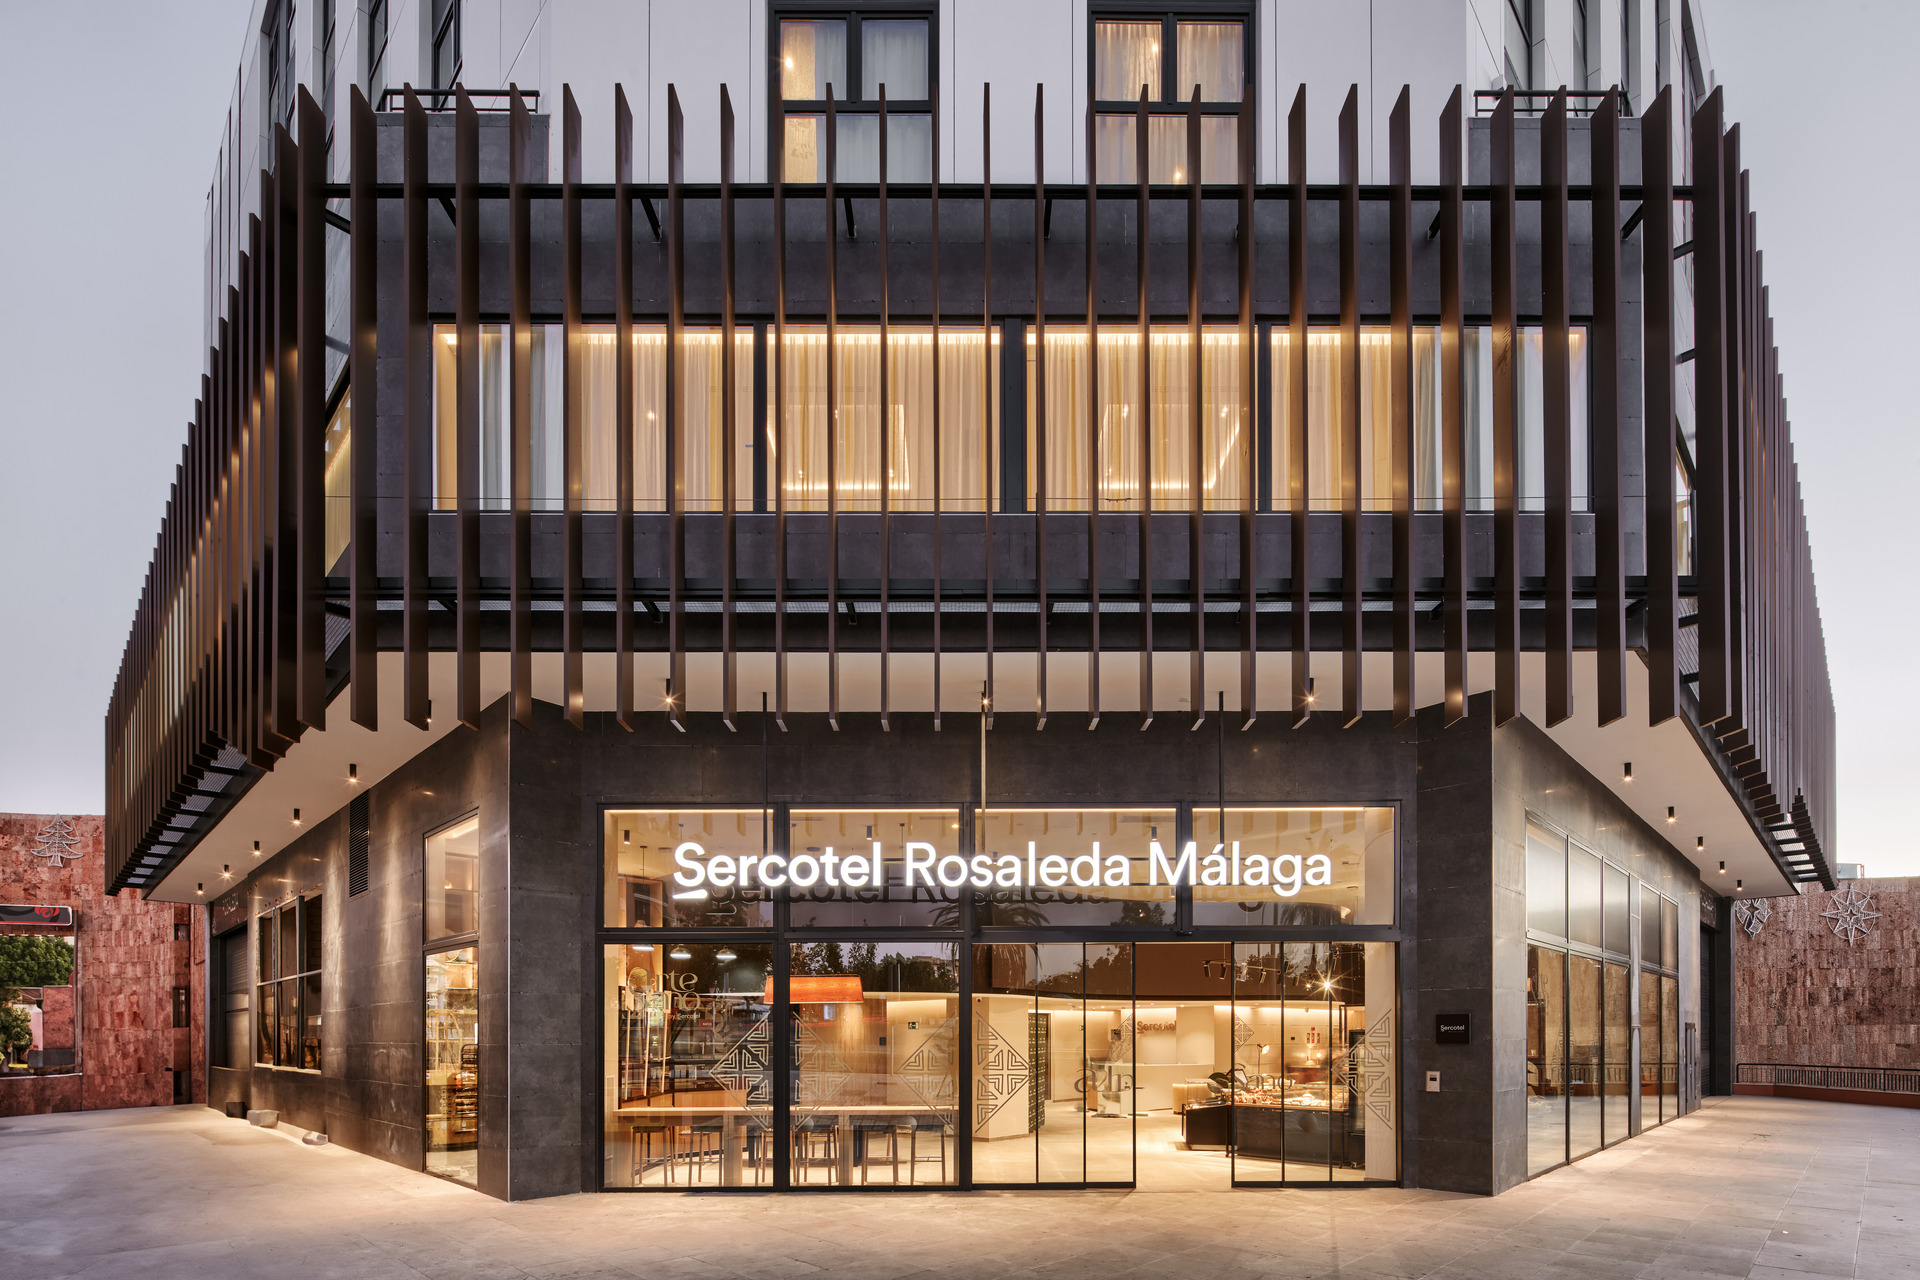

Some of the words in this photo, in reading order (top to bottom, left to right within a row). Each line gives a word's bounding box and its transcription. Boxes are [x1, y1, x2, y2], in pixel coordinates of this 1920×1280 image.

[673, 841, 882, 900] Sercotel
[905, 841, 1131, 887] Rosaleda
[1149, 841, 1332, 897] Málaga
[1440, 1024, 1465, 1032] Sercotel
